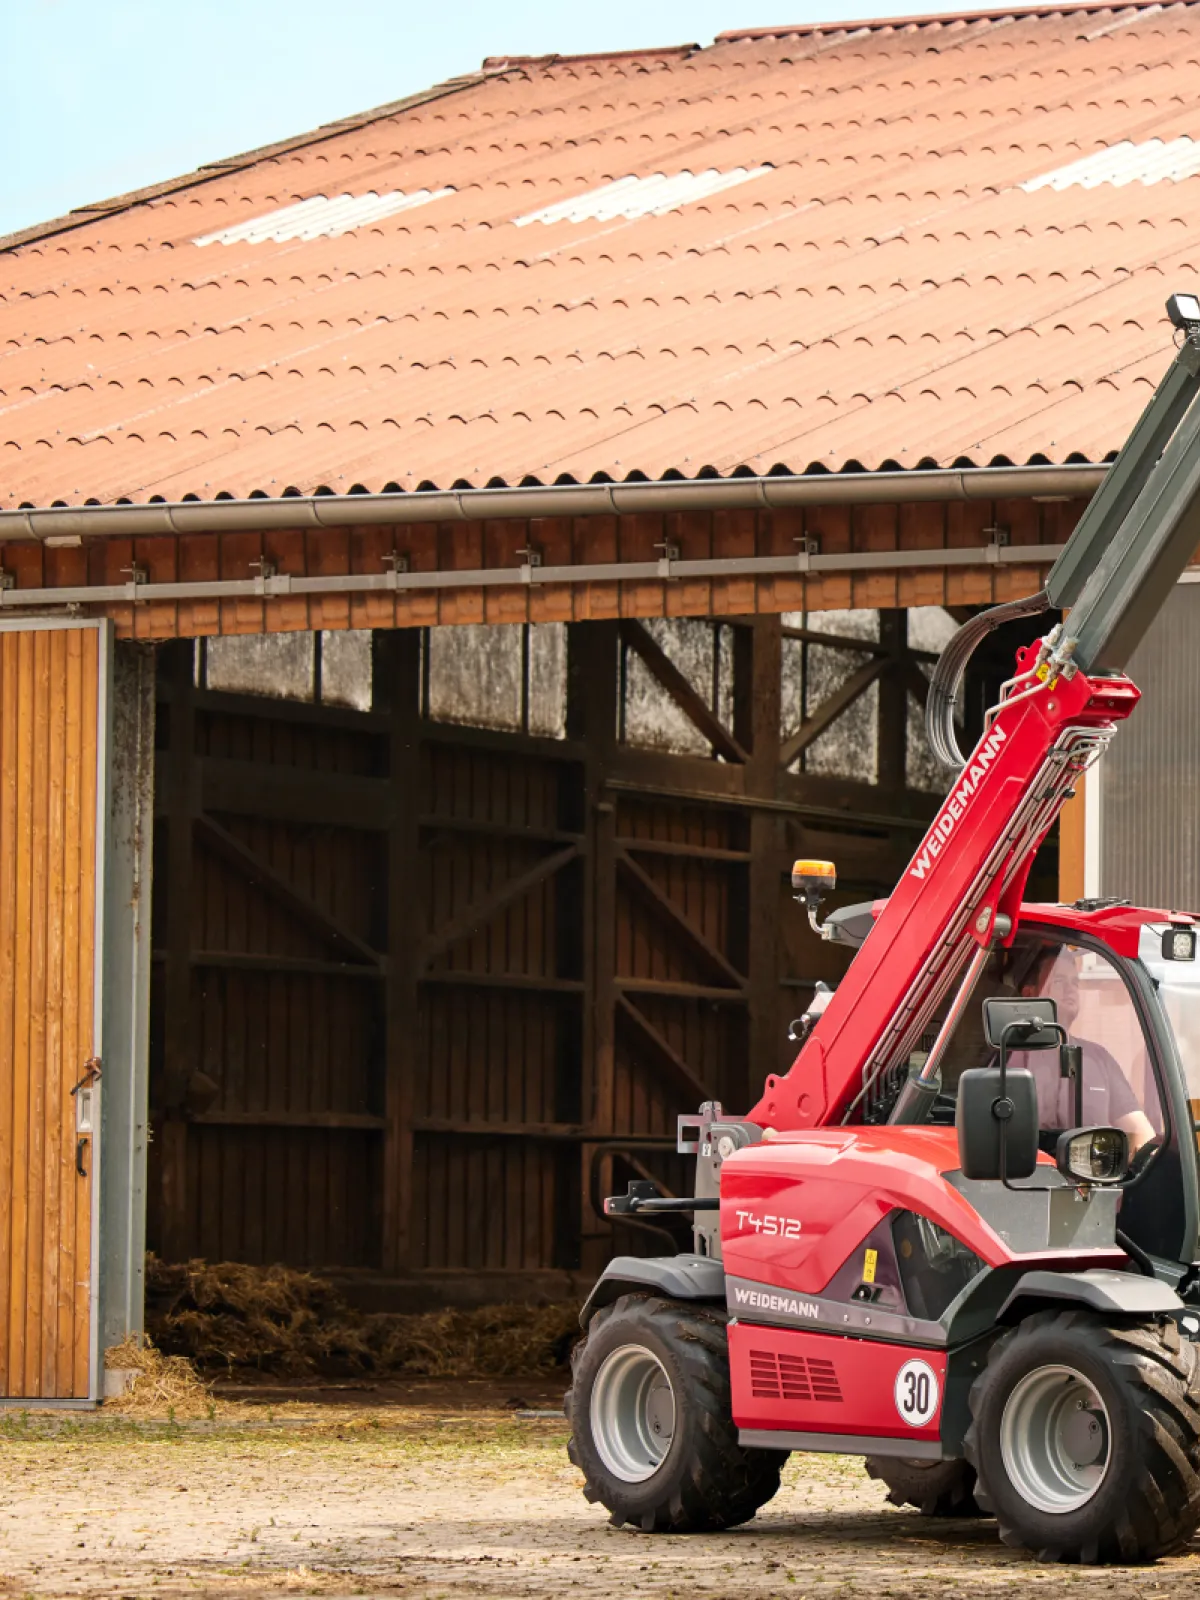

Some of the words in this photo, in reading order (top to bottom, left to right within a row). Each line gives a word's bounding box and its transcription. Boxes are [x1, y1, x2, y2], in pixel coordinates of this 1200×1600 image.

[910, 724, 1007, 879] WEIDEMANN
[736, 1210, 801, 1239] T4512
[735, 1287, 819, 1318] WEIDEMANN
[903, 1371, 930, 1414] 30
